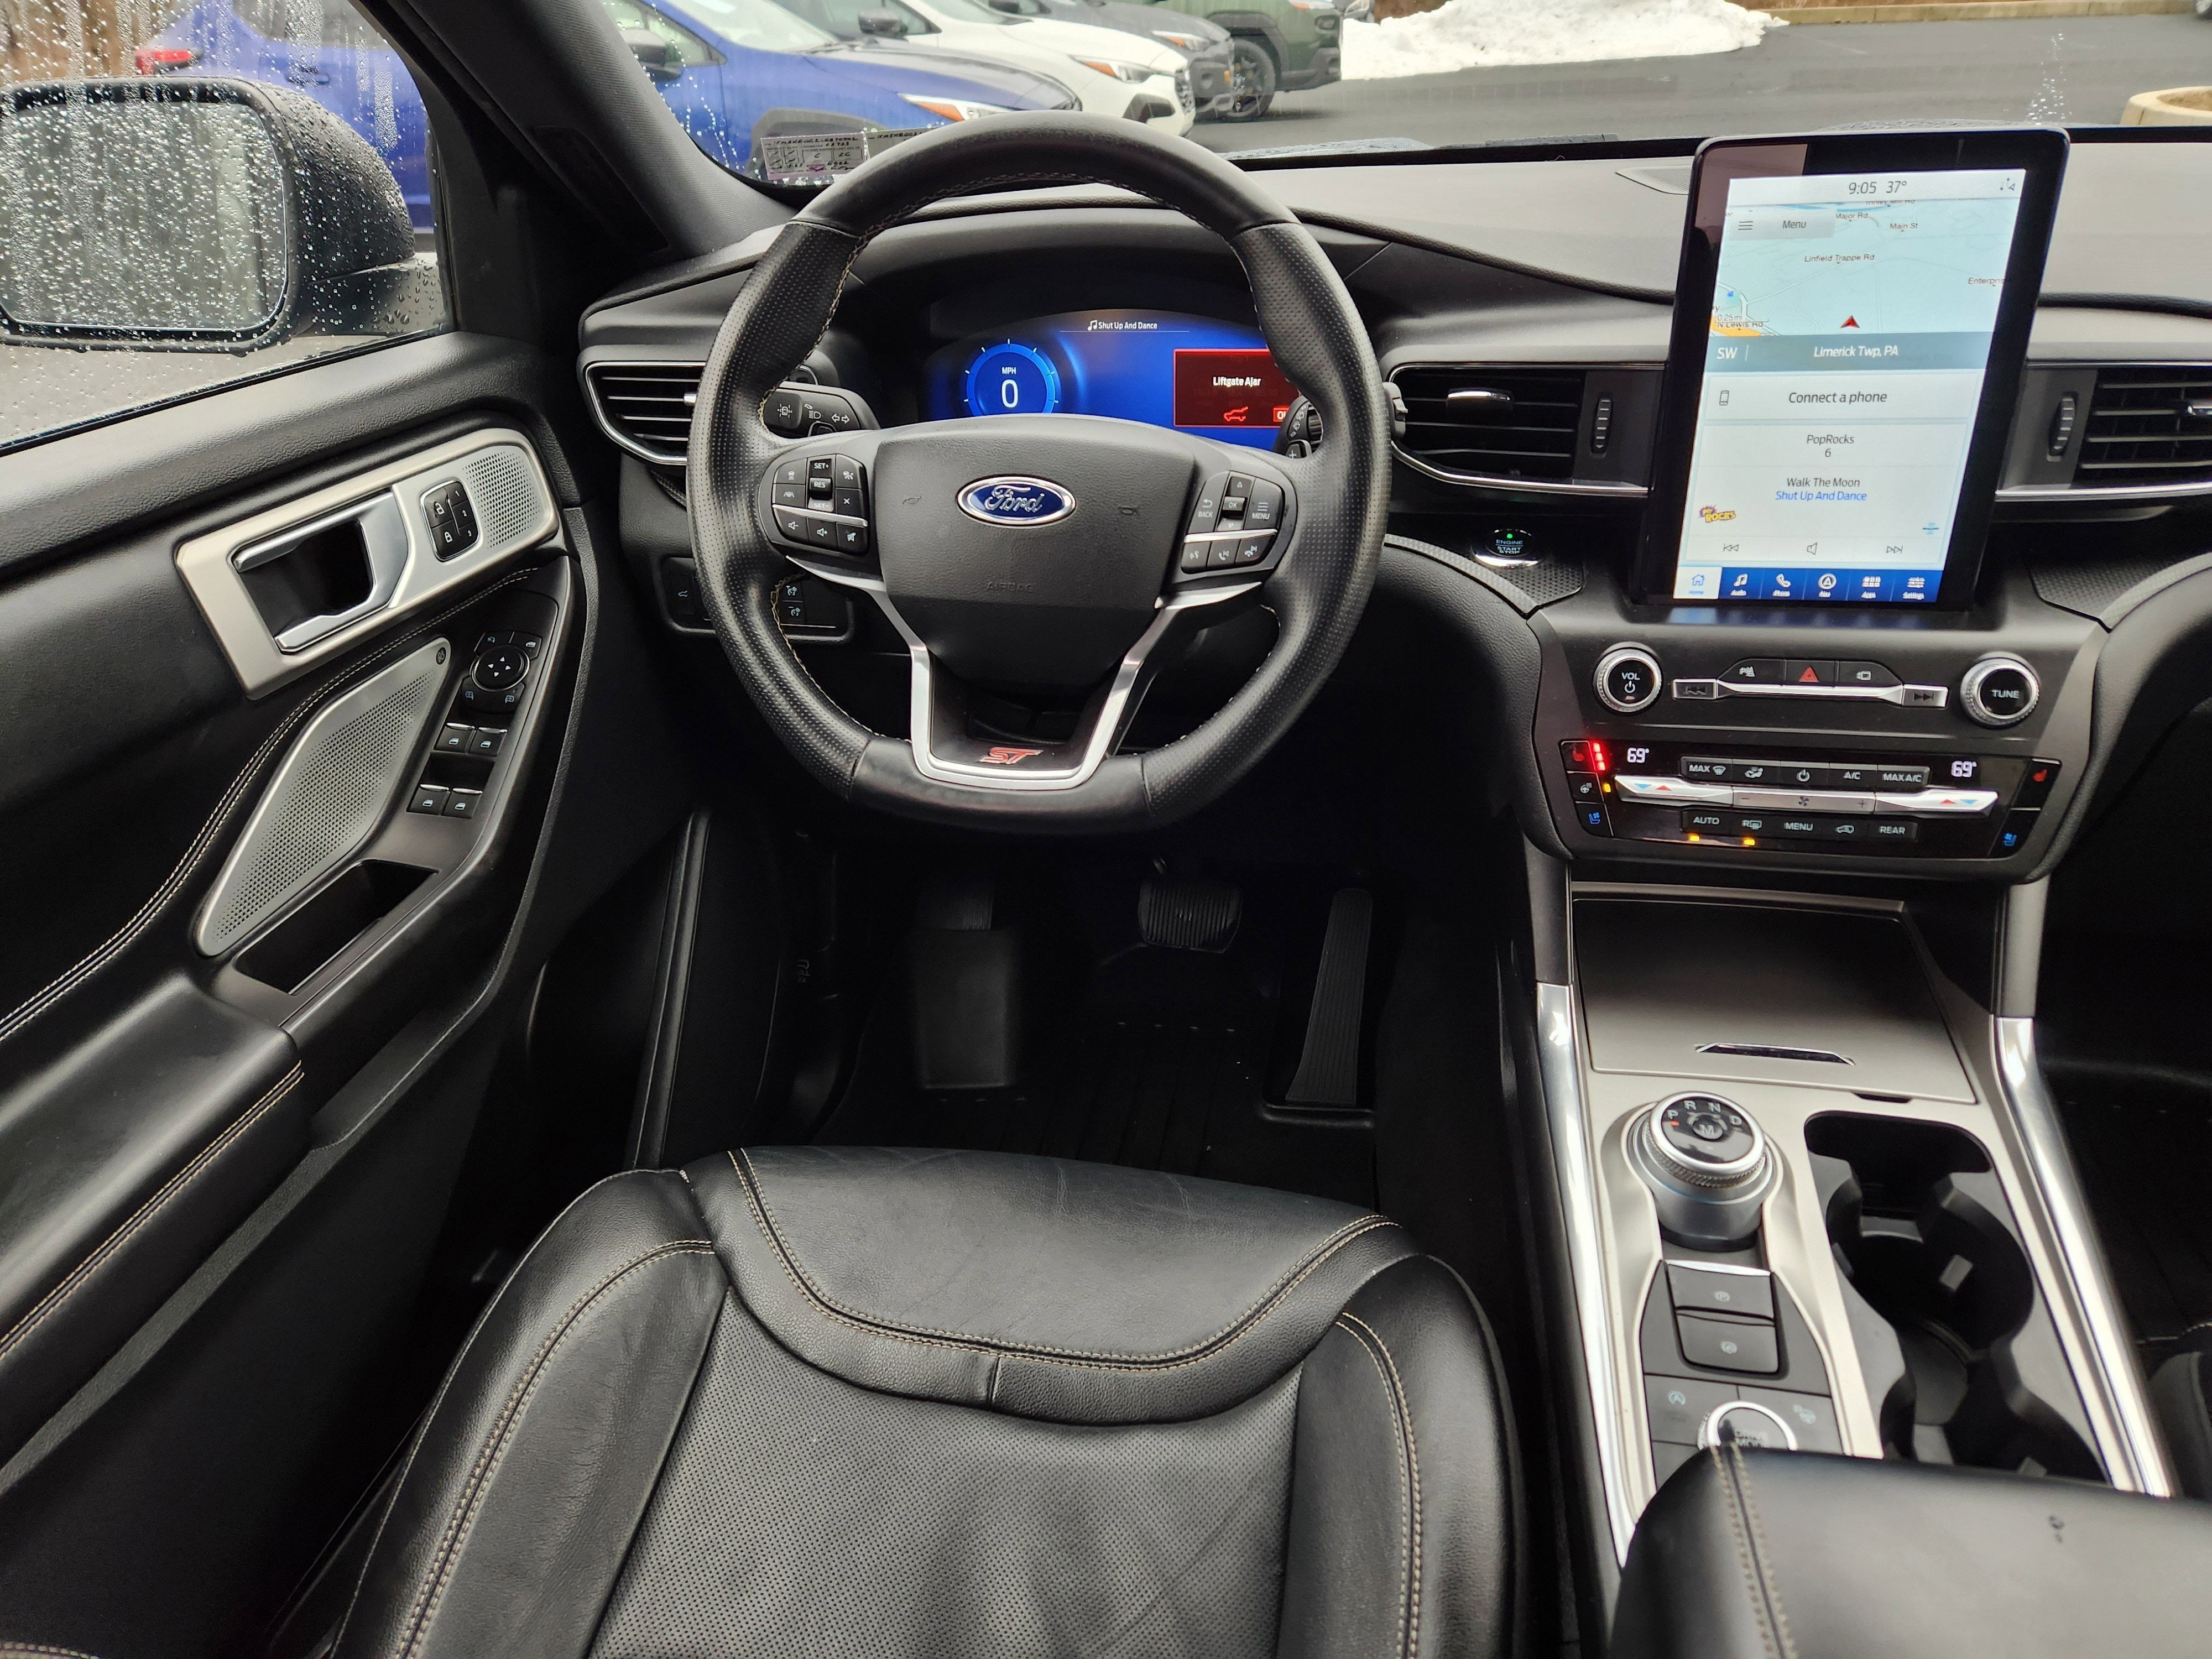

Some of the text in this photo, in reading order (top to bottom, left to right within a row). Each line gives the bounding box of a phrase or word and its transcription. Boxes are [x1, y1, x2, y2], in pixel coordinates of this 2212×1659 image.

[1849, 180, 1907, 194] 9:05 37°
[1782, 220, 1807, 229] Menu
[1835, 254, 1862, 263] Trappe
[1098, 321, 1157, 330] Shut Up And Dance
[1717, 346, 1738, 359] SW
[1813, 345, 1898, 358] Limerick Twp, PA
[1001, 366, 1017, 375] MPH
[1212, 376, 1261, 388] Liftgate Ajar
[1001, 379, 1018, 408] 0
[1788, 391, 1887, 405] Connect a phone
[1806, 434, 1855, 446] PopRocks
[1825, 448, 1832, 458] 6
[1787, 477, 1860, 487] Walk The Moon
[984, 484, 1045, 513] Ford
[1775, 491, 1867, 502] Shut Up And Dance
[1621, 672, 1641, 681] VOL
[1991, 689, 2020, 699] TUNE
[979, 747, 1044, 765] ST
[1688, 764, 1711, 774] MAX
[1843, 771, 1861, 781] A/C
[1882, 773, 1923, 783] MAX A/C
[1693, 816, 1720, 825] AUTO
[1785, 822, 1814, 831] MENU
[1879, 826, 1906, 834] REAR
[1667, 1100, 1742, 1125] P R N D
[1700, 1124, 1714, 1135] M
